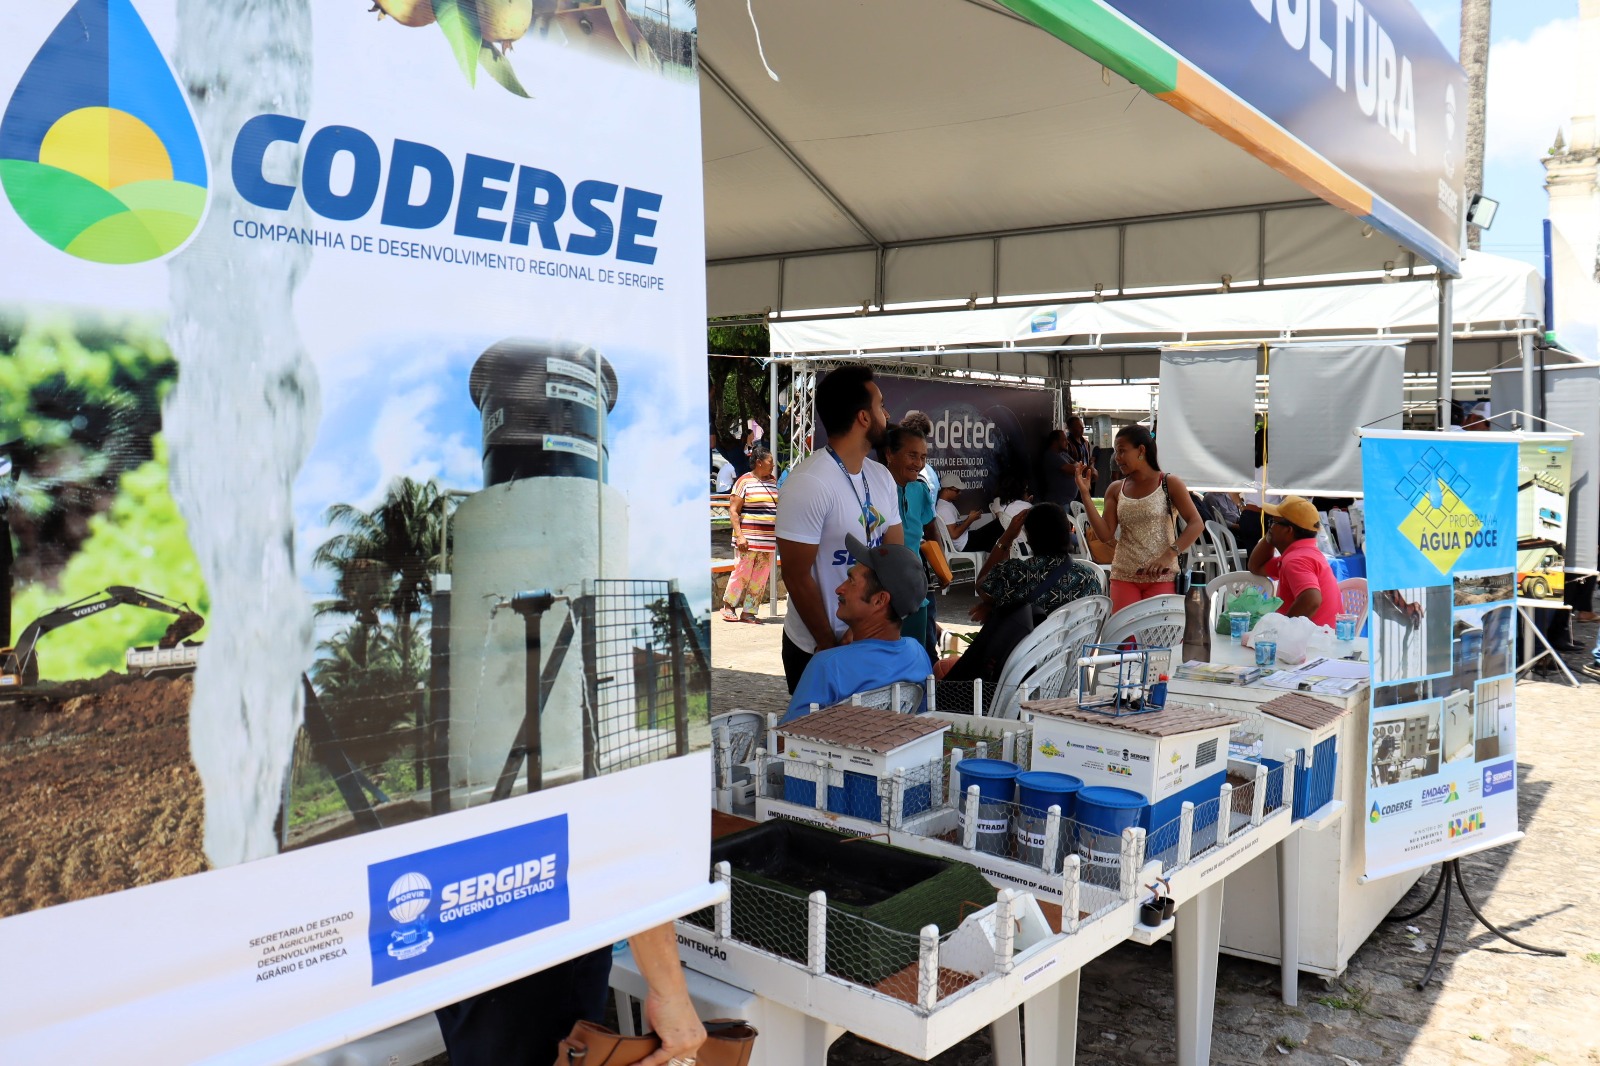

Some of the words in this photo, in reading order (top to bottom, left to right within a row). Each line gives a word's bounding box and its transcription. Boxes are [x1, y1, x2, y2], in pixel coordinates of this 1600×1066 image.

[1252, 0, 1416, 156] LTURA
[231, 113, 663, 265] CODERSE
[233, 219, 345, 250] COMPANHIA
[350, 234, 373, 253] DE
[378, 238, 526, 273] DESENVOLVIMENTO
[529, 259, 595, 282] REGIONAL
[598, 268, 615, 284] DE
[617, 271, 664, 291] SERGIPE
[925, 457, 949, 467] RETARIA
[956, 457, 976, 466] ESTADO
[976, 457, 984, 466] DO
[960, 468, 989, 478] ECONÔMICO
[965, 480, 984, 490] OLOGIA
[1449, 513, 1498, 528] PROGRAMA
[1420, 527, 1461, 551] ÁGUA
[1464, 529, 1498, 549] DOCE
[72, 603, 107, 617] VOLVO
[1130, 752, 1151, 761] SERGIPE
[1381, 800, 1413, 816] CODERSE
[1447, 811, 1486, 838] BRASIL
[440, 853, 557, 911] SERGIPE
[395, 890, 425, 905] PORVIR
[440, 897, 495, 923] GOVERNO
[496, 892, 512, 906] DO
[513, 878, 555, 900] ESTADO
[249, 926, 304, 948] SECRETARIA
[306, 921, 318, 932] DE
[319, 911, 354, 927] ESTADO
[263, 946, 276, 955] DA
[278, 927, 340, 950] AGRICULTURA,
[257, 936, 344, 969] DESENVOLVIMENTO
[675, 933, 727, 961] ONTENÇÃO
[256, 963, 297, 982] AGRÁRIO
[298, 960, 304, 969] E
[305, 957, 318, 967] DA
[319, 948, 348, 962] PESCA
